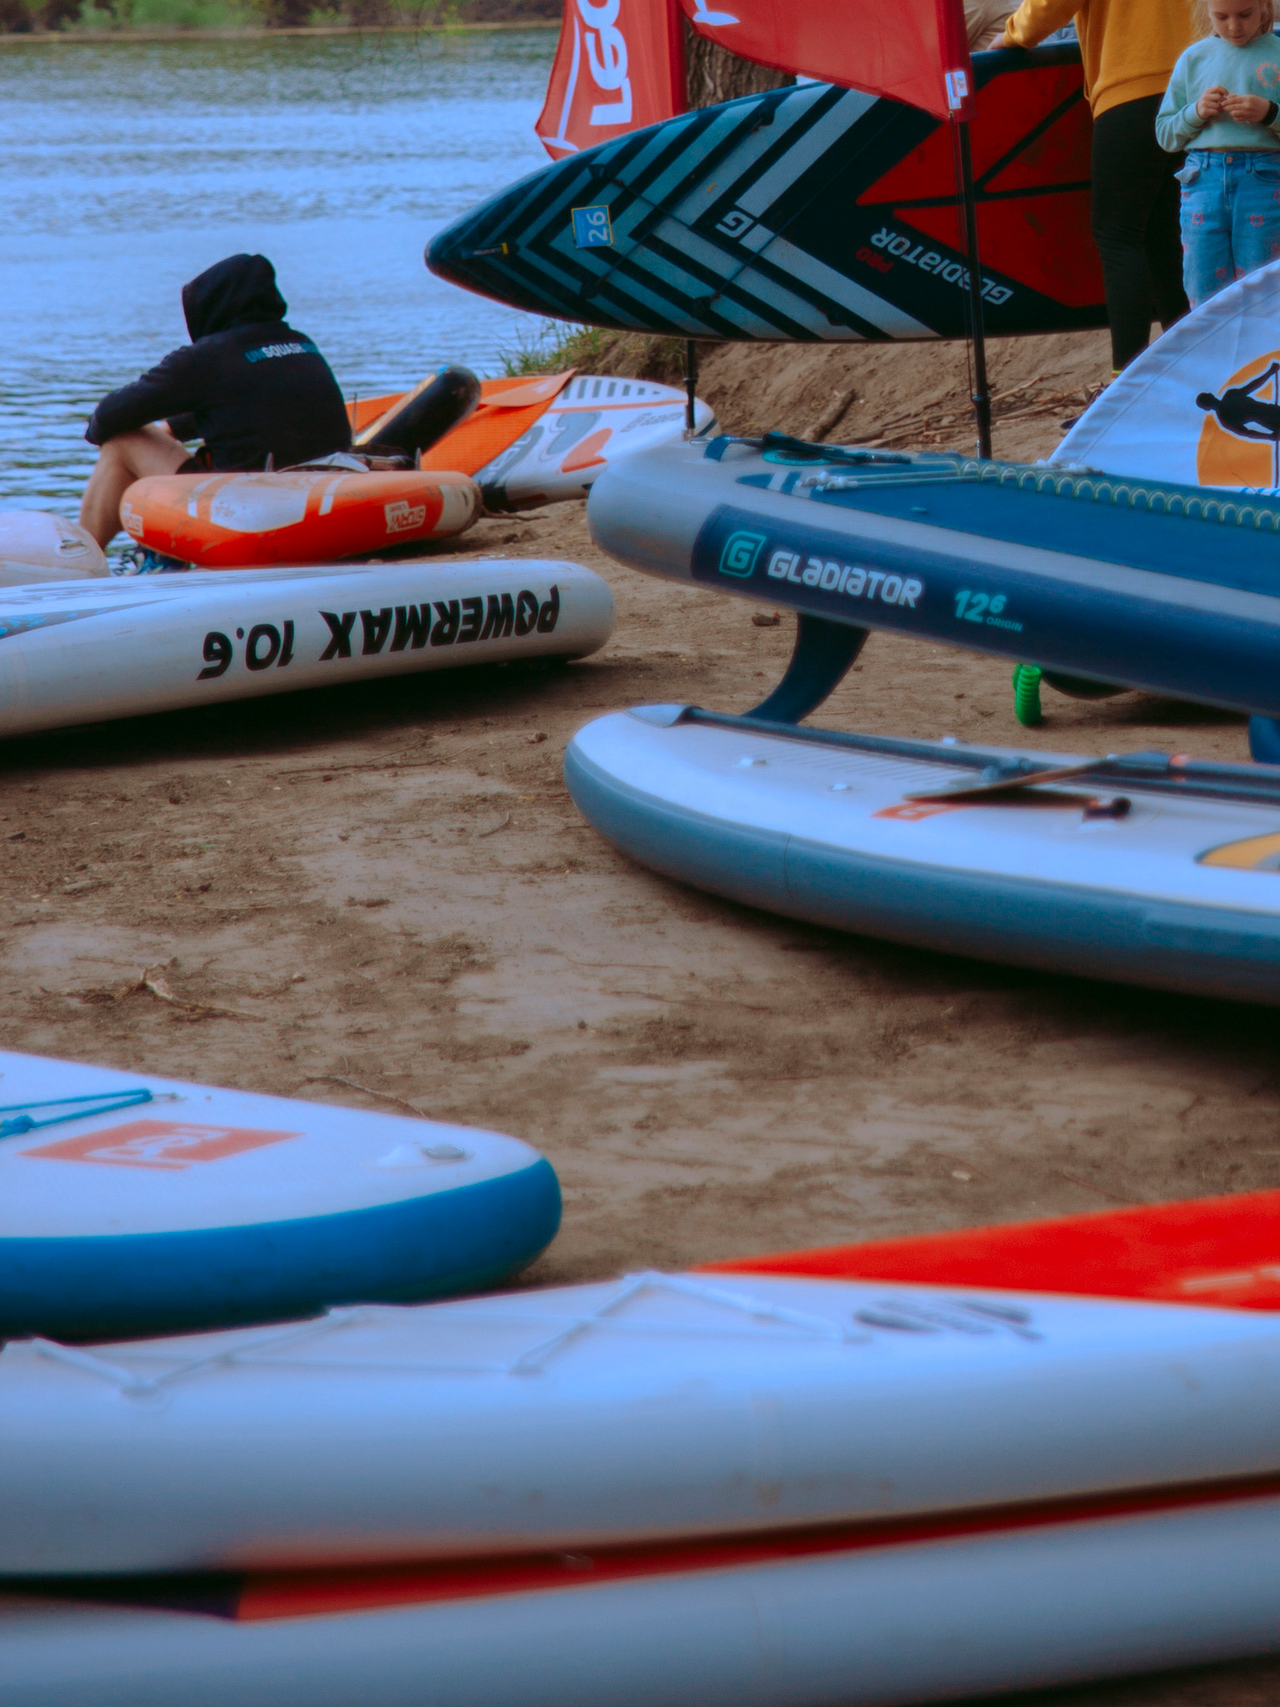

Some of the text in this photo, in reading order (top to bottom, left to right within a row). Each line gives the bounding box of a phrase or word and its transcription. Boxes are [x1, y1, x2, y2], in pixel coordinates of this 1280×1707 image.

[588, 210, 609, 243] 26
[856, 247, 895, 273] PRO
[767, 551, 924, 608] GLADIATOR
[196, 584, 561, 682] POWERMAX 10.6
[986, 616, 1023, 632] ORIGIN
